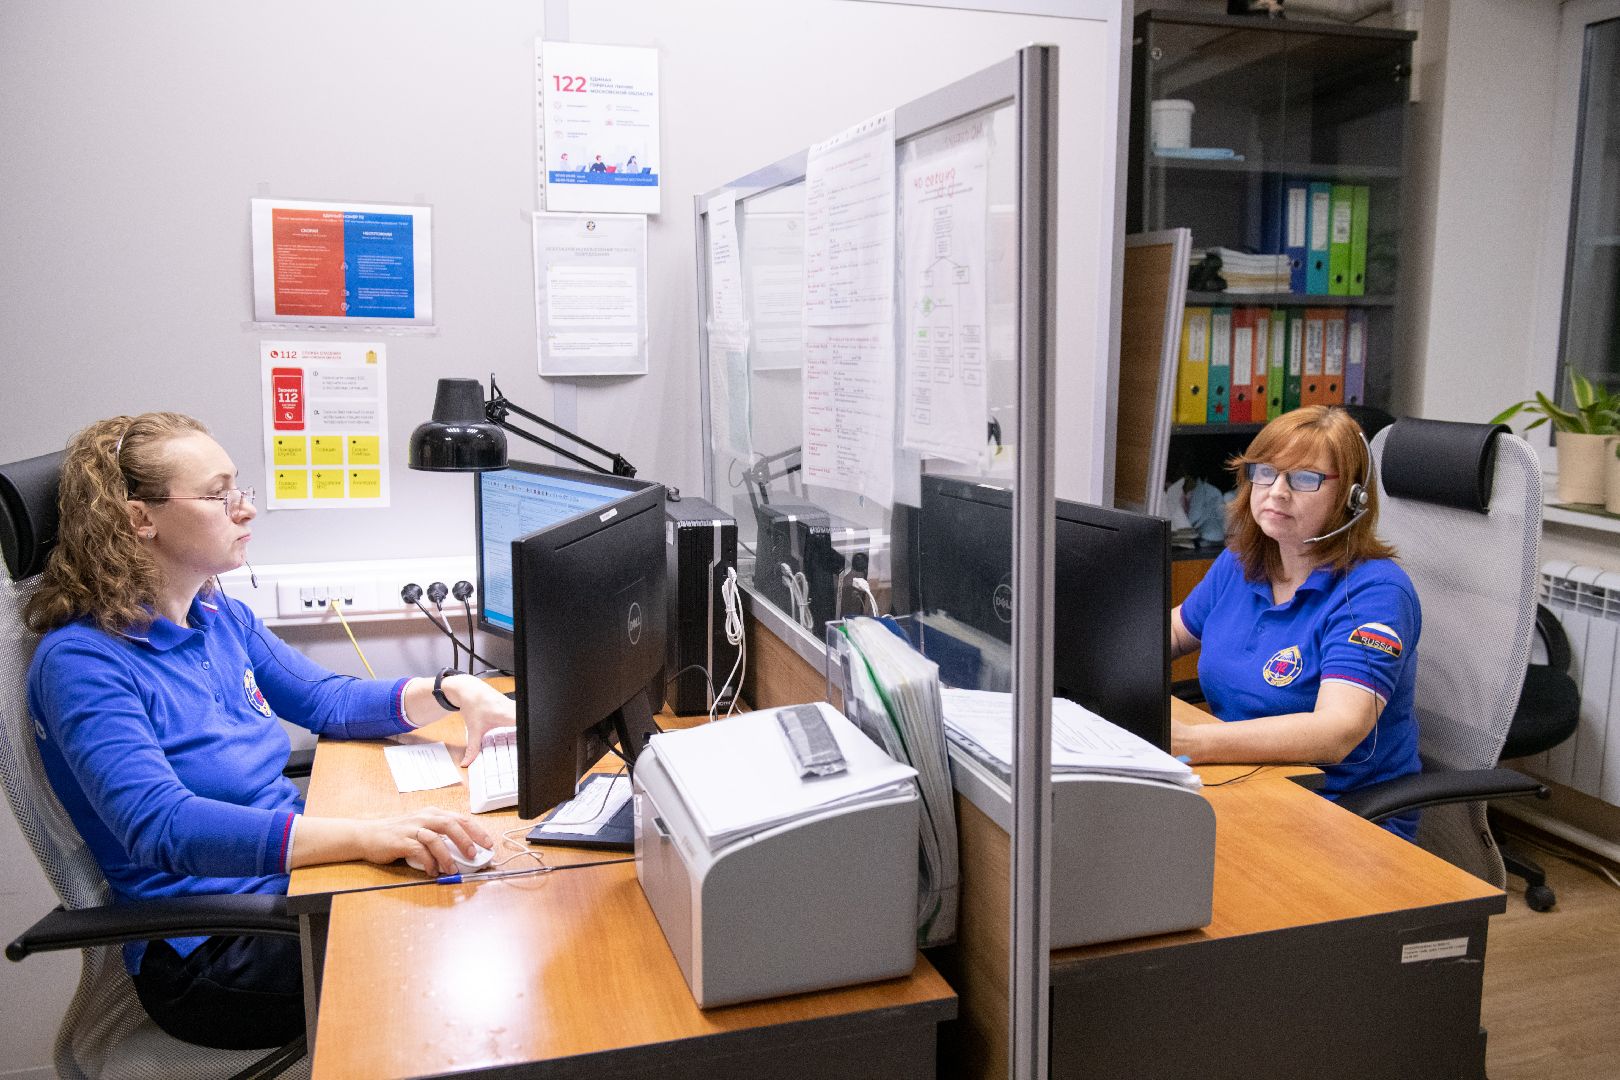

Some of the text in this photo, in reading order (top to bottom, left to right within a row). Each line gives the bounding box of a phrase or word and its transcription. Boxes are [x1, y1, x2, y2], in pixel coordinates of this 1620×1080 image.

[553, 75, 587, 93] 122
[278, 393, 298, 403] 112
[1361, 636, 1394, 652] RUSSIA
